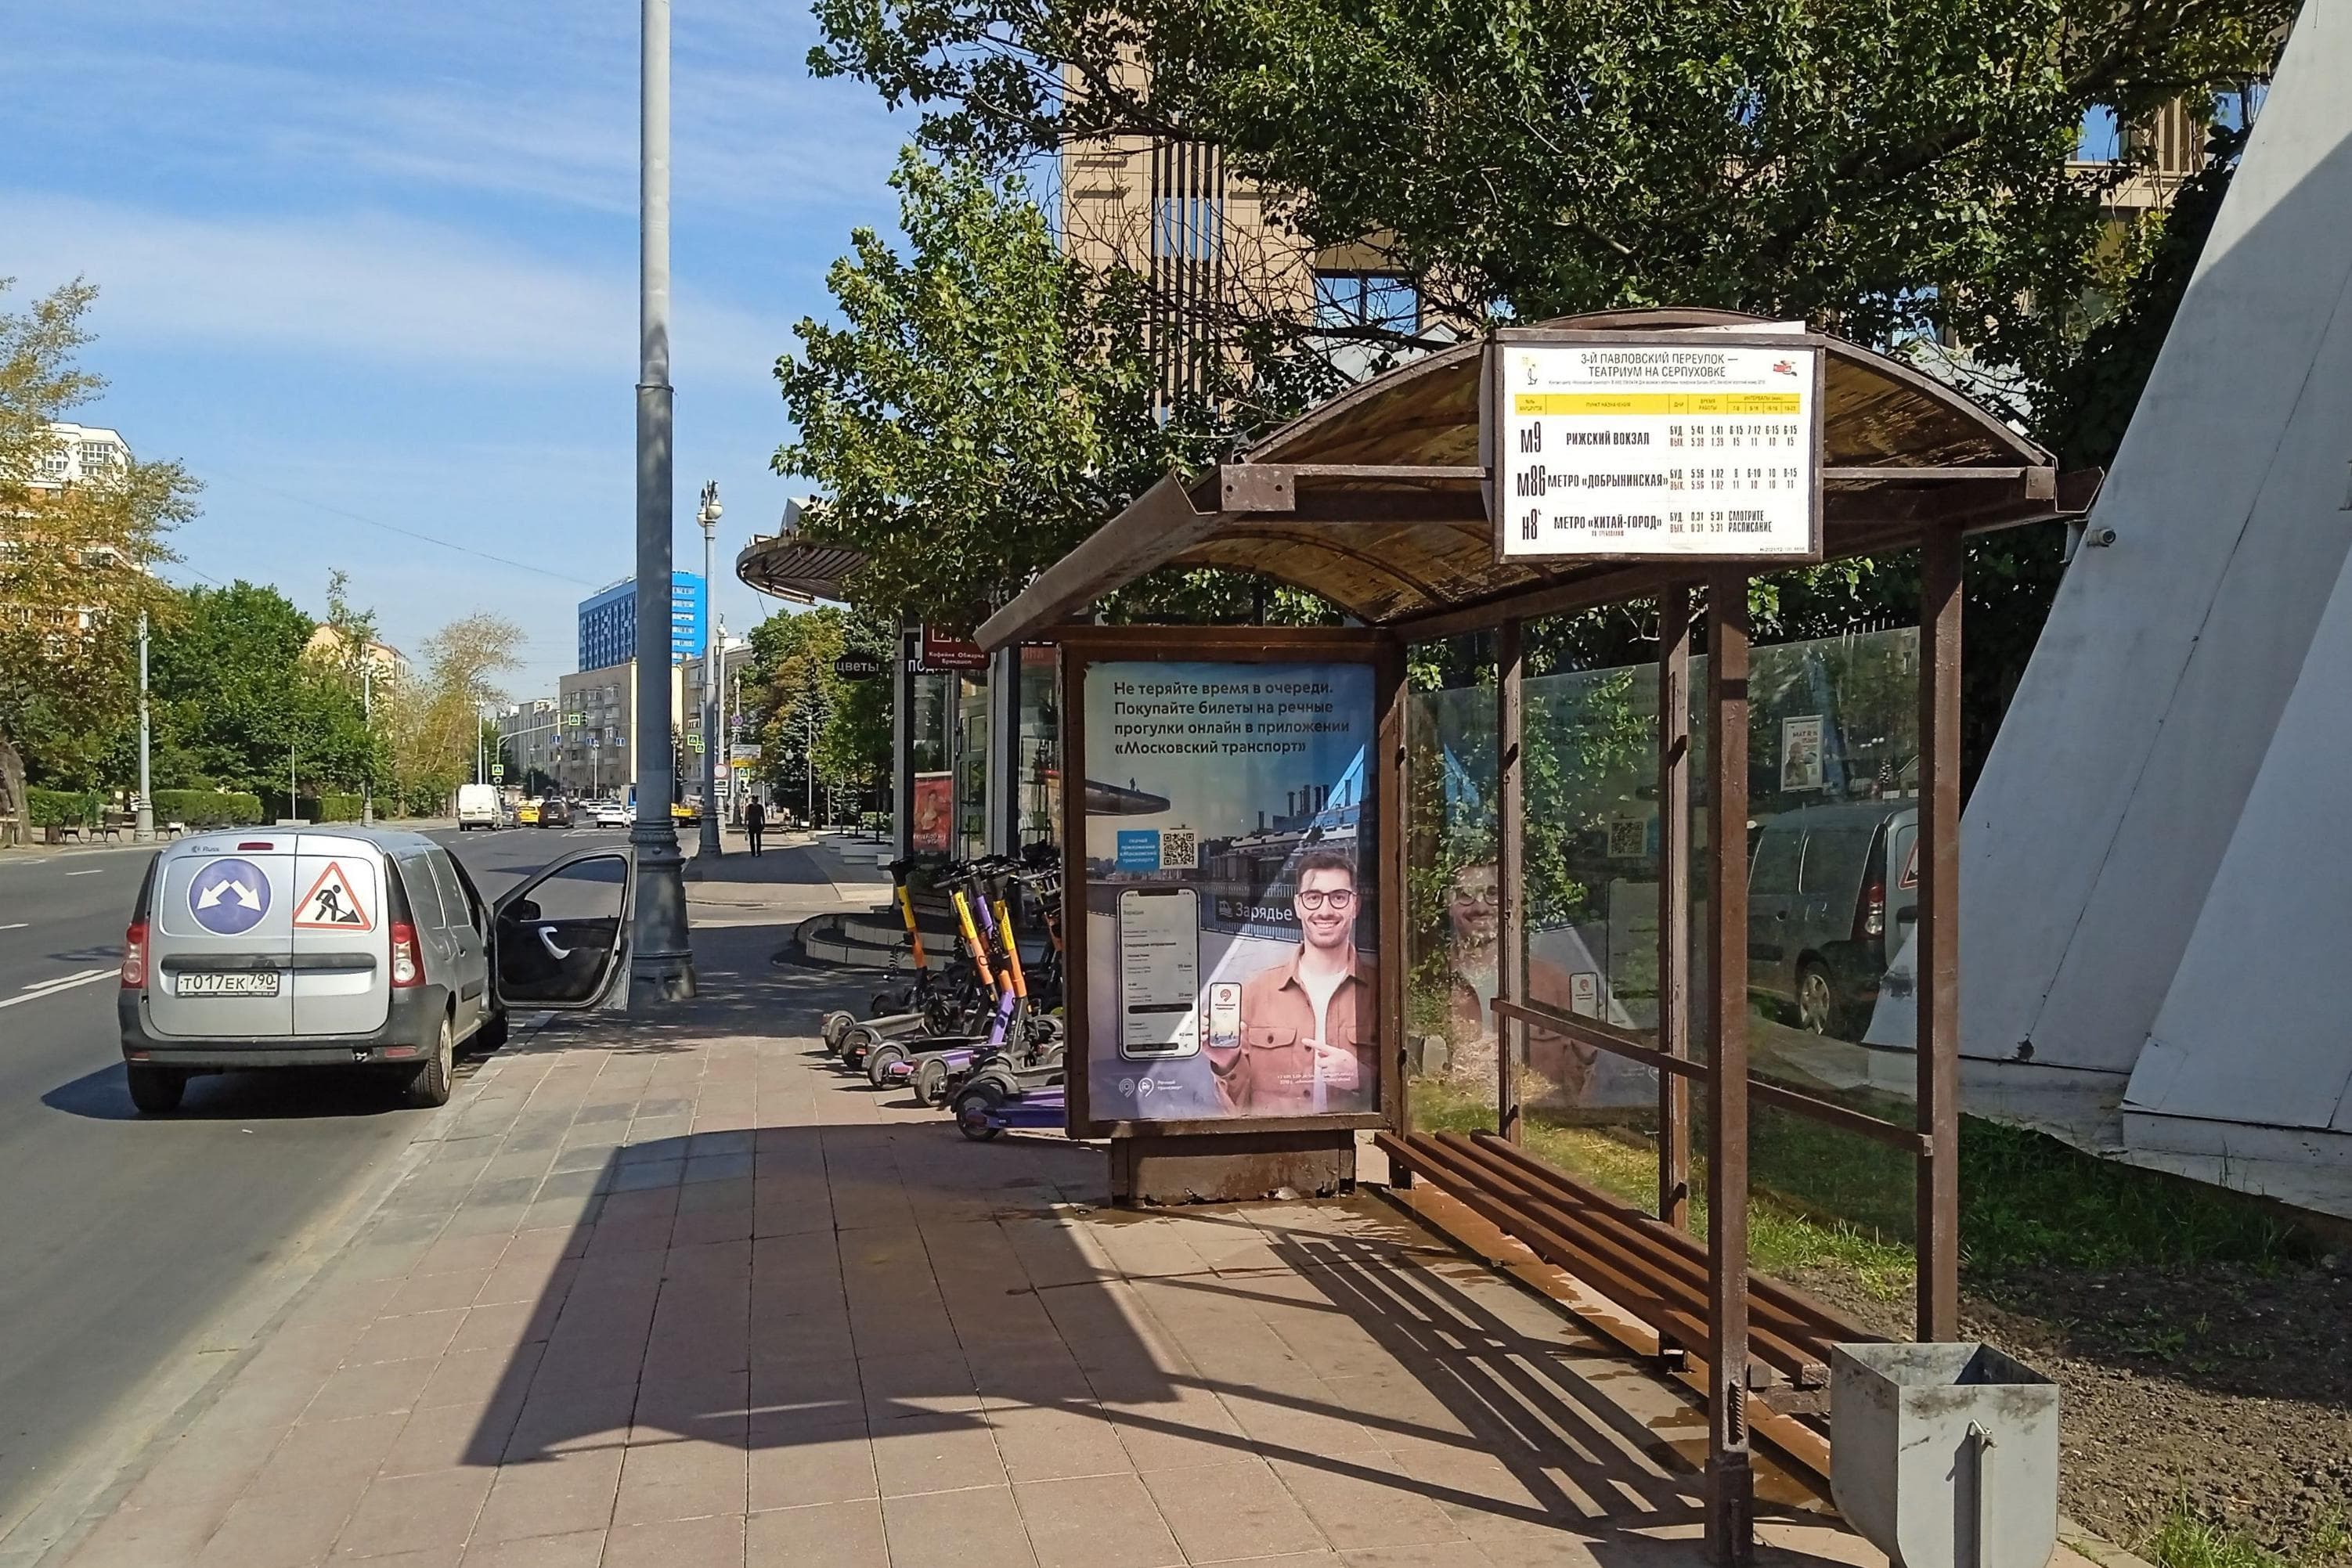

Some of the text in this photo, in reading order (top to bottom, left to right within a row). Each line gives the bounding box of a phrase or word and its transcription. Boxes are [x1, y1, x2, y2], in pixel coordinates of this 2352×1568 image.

[1581, 351, 1597, 364] 3-Й
[1600, 351, 1669, 365] ПАВЛОВСКИЙ
[1672, 353, 1724, 365] ПЕРЕУЛОК
[1589, 366, 1726, 377] ТЕАТРИУМ НА СЕРПУХОВКЕ
[1566, 431, 1650, 445] РИЖСКИЙ ВОКЗАЛ
[1547, 474, 1668, 489] МЕТРО «ДОБРЫНИНСКАЯ»
[1553, 514, 1662, 530] МЕТРО «КИТАЙ-ГОРОД»
[1728, 512, 1764, 521] СМОТРИТЕ
[1728, 523, 1773, 532] РАСПИСАНИЕ
[836, 661, 879, 673] цветы
[1114, 681, 1333, 697] Не теряйте время в очереди.
[1115, 701, 1333, 717] Покупайте билеты на речные
[1115, 721, 1350, 737] прогулки онлайн в приложении
[1115, 741, 1307, 756] «Московский транспорт»
[1236, 901, 1293, 922] Зарядье
[250, 973, 274, 986] 790
